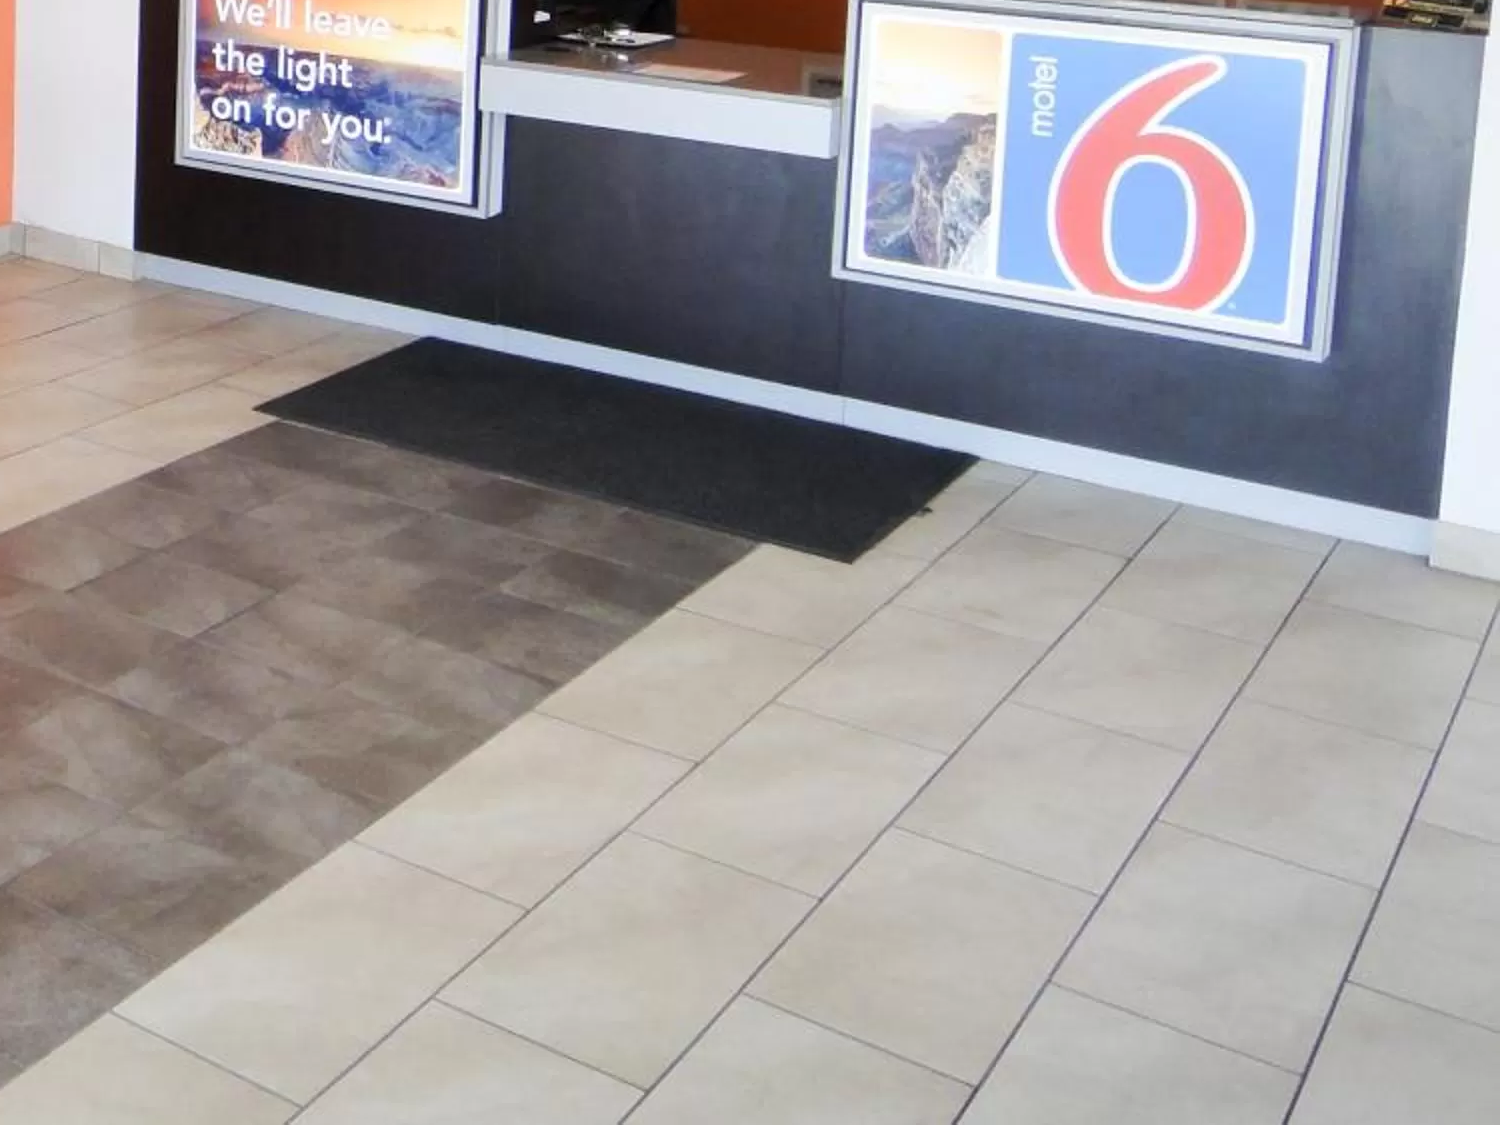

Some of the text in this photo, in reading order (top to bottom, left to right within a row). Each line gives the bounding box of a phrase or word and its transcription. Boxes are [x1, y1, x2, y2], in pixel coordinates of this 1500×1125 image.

[212, 38, 353, 92] the light
[1028, 55, 1058, 137] motel
[211, 96, 251, 124] on
[263, 93, 310, 132] for
[1047, 54, 1256, 316] 6
